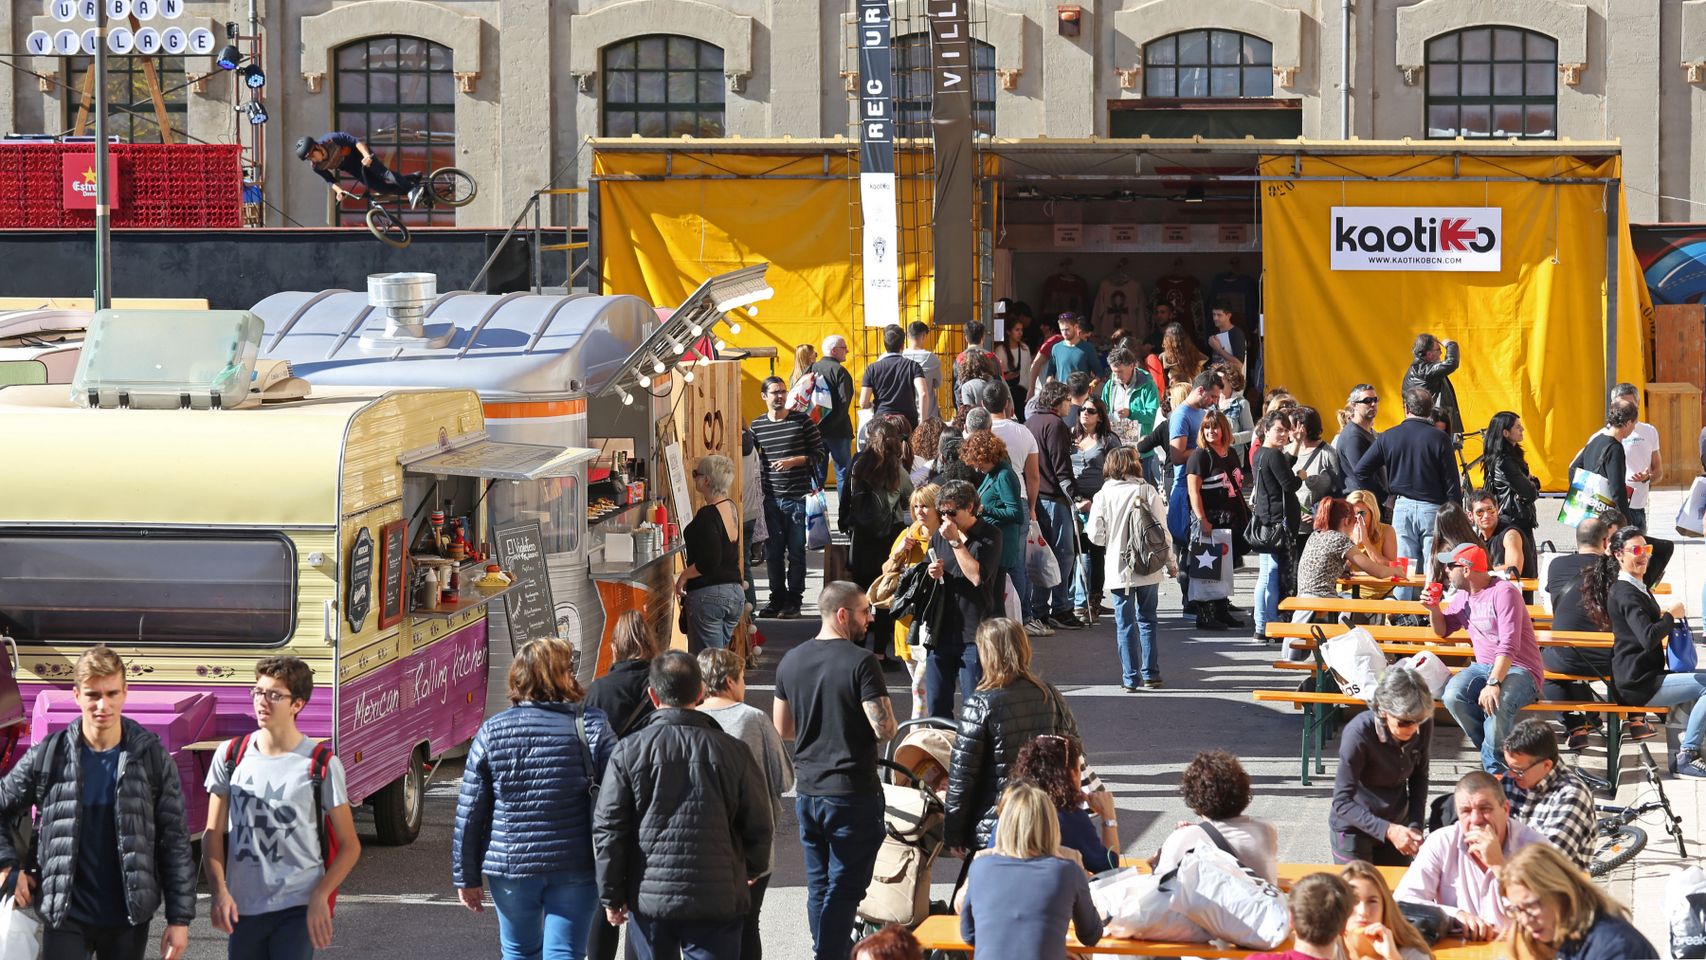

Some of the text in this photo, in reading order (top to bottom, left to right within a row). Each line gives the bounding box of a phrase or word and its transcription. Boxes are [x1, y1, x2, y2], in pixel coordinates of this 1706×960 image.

[60, 1, 175, 17] URBAN
[867, 79, 884, 138] REC
[353, 689, 399, 730] Mexican
[414, 658, 448, 704] Rolling
